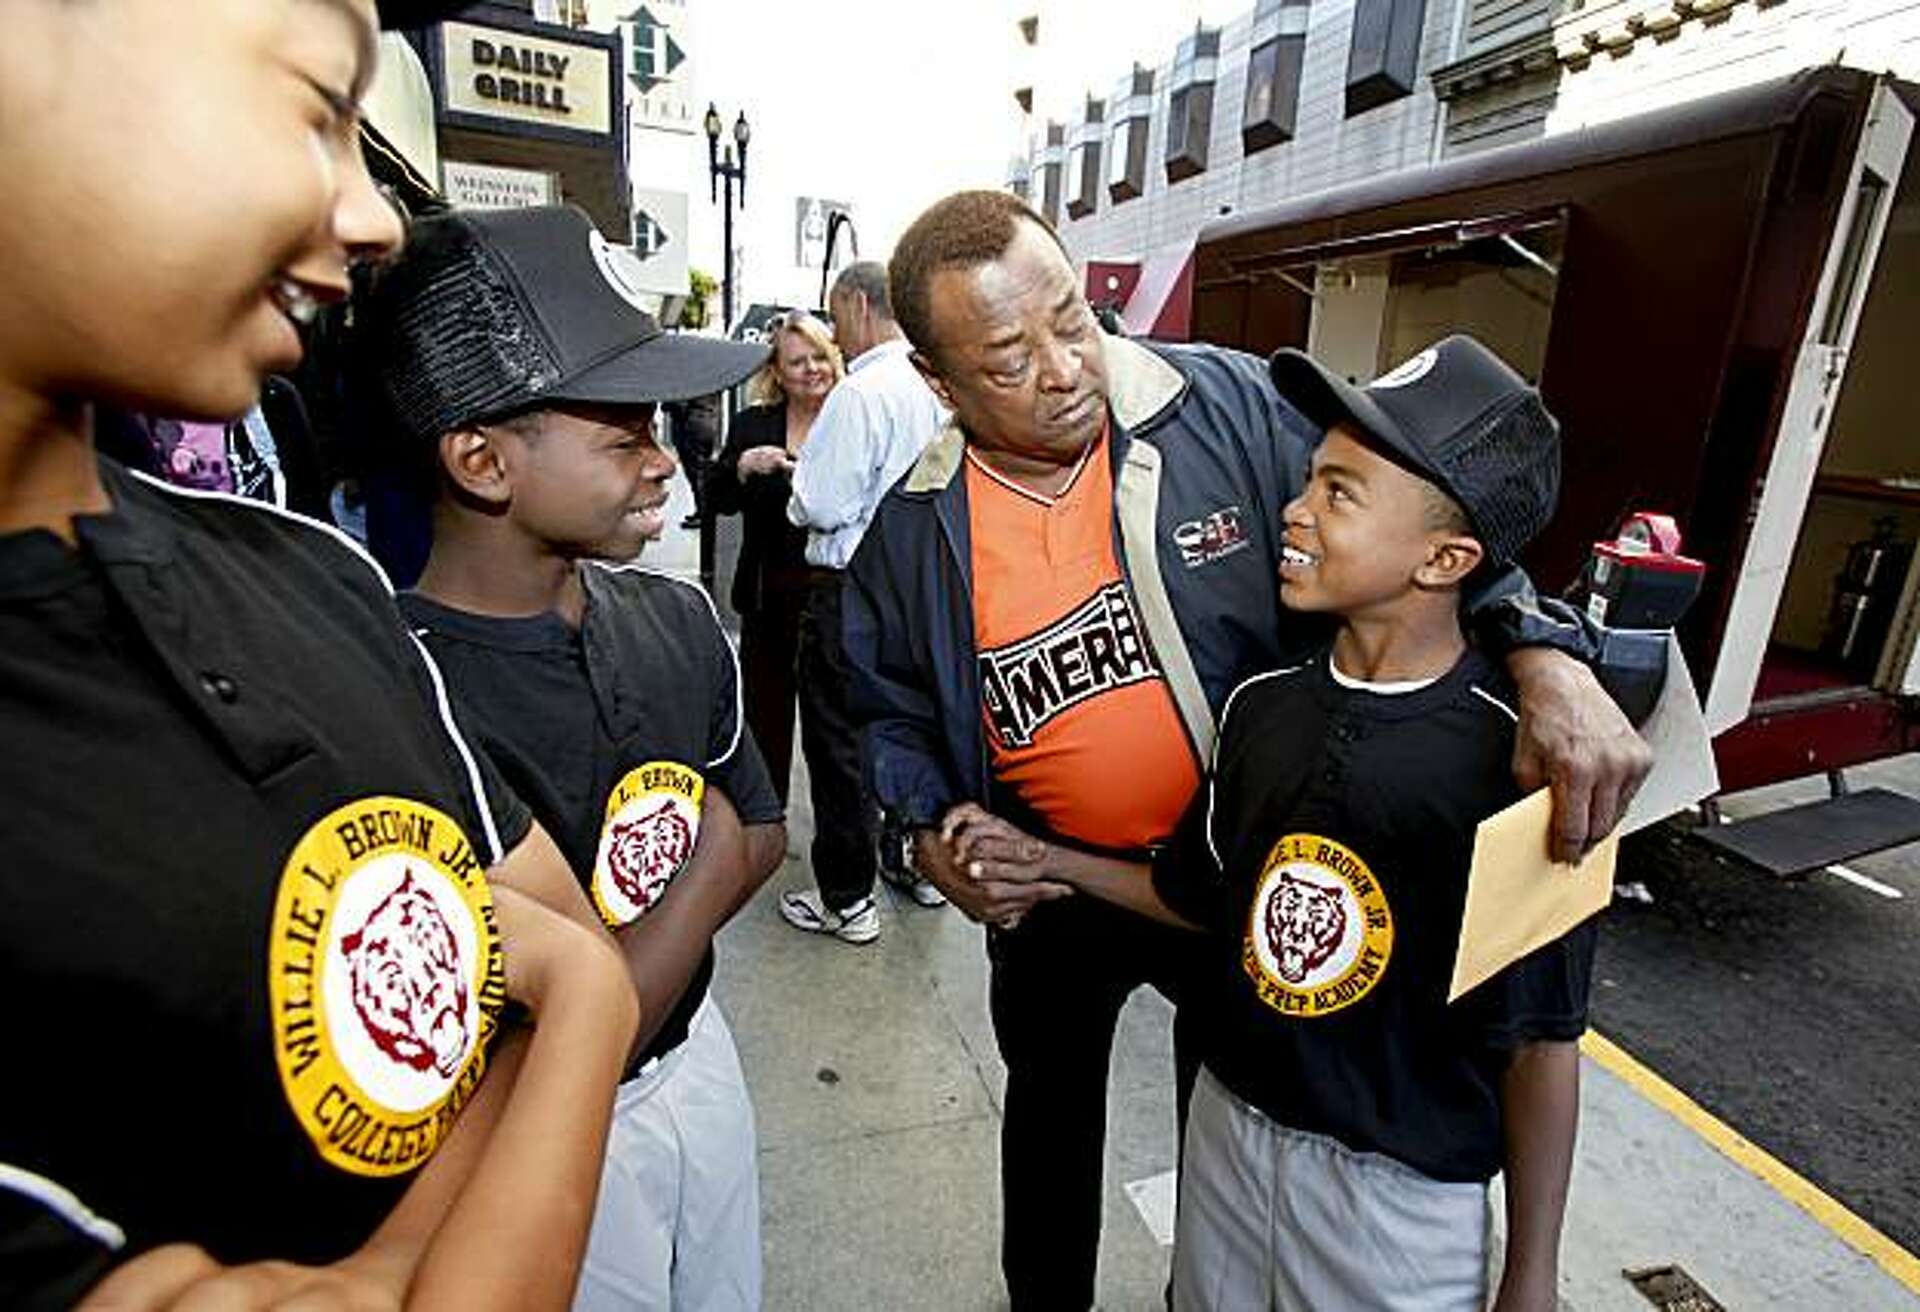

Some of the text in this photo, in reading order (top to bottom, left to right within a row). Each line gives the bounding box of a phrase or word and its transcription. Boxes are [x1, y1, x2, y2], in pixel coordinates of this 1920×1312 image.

[472, 38, 570, 80] DAILY
[474, 73, 572, 113] GRILL
[1315, 844, 1375, 898] BROWN
[284, 898, 325, 1077] WILLIE
[336, 809, 435, 861] BROWN
[440, 837, 476, 888] JR.
[1314, 945, 1384, 1010] ACADEMY
[312, 1084, 437, 1166] COLLEGE
